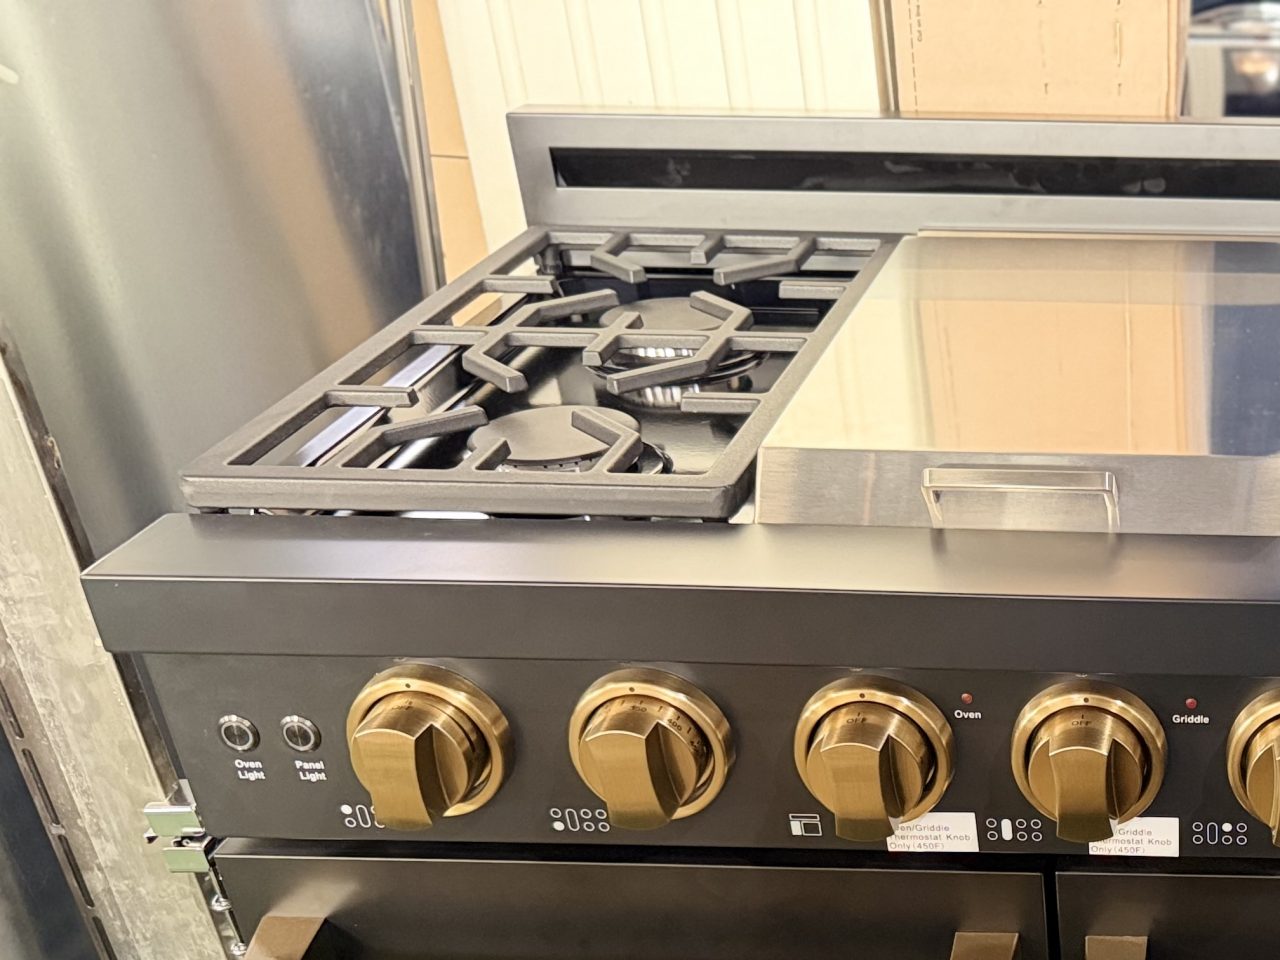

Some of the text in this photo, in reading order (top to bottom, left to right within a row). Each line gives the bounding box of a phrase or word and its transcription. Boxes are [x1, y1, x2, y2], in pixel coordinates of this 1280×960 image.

[954, 709, 982, 719] Oven
[1172, 714, 1210, 724] Griddle
[234, 759, 262, 769] Oven
[294, 760, 325, 770] Panel
[237, 770, 266, 781] Light
[299, 771, 327, 782] Light
